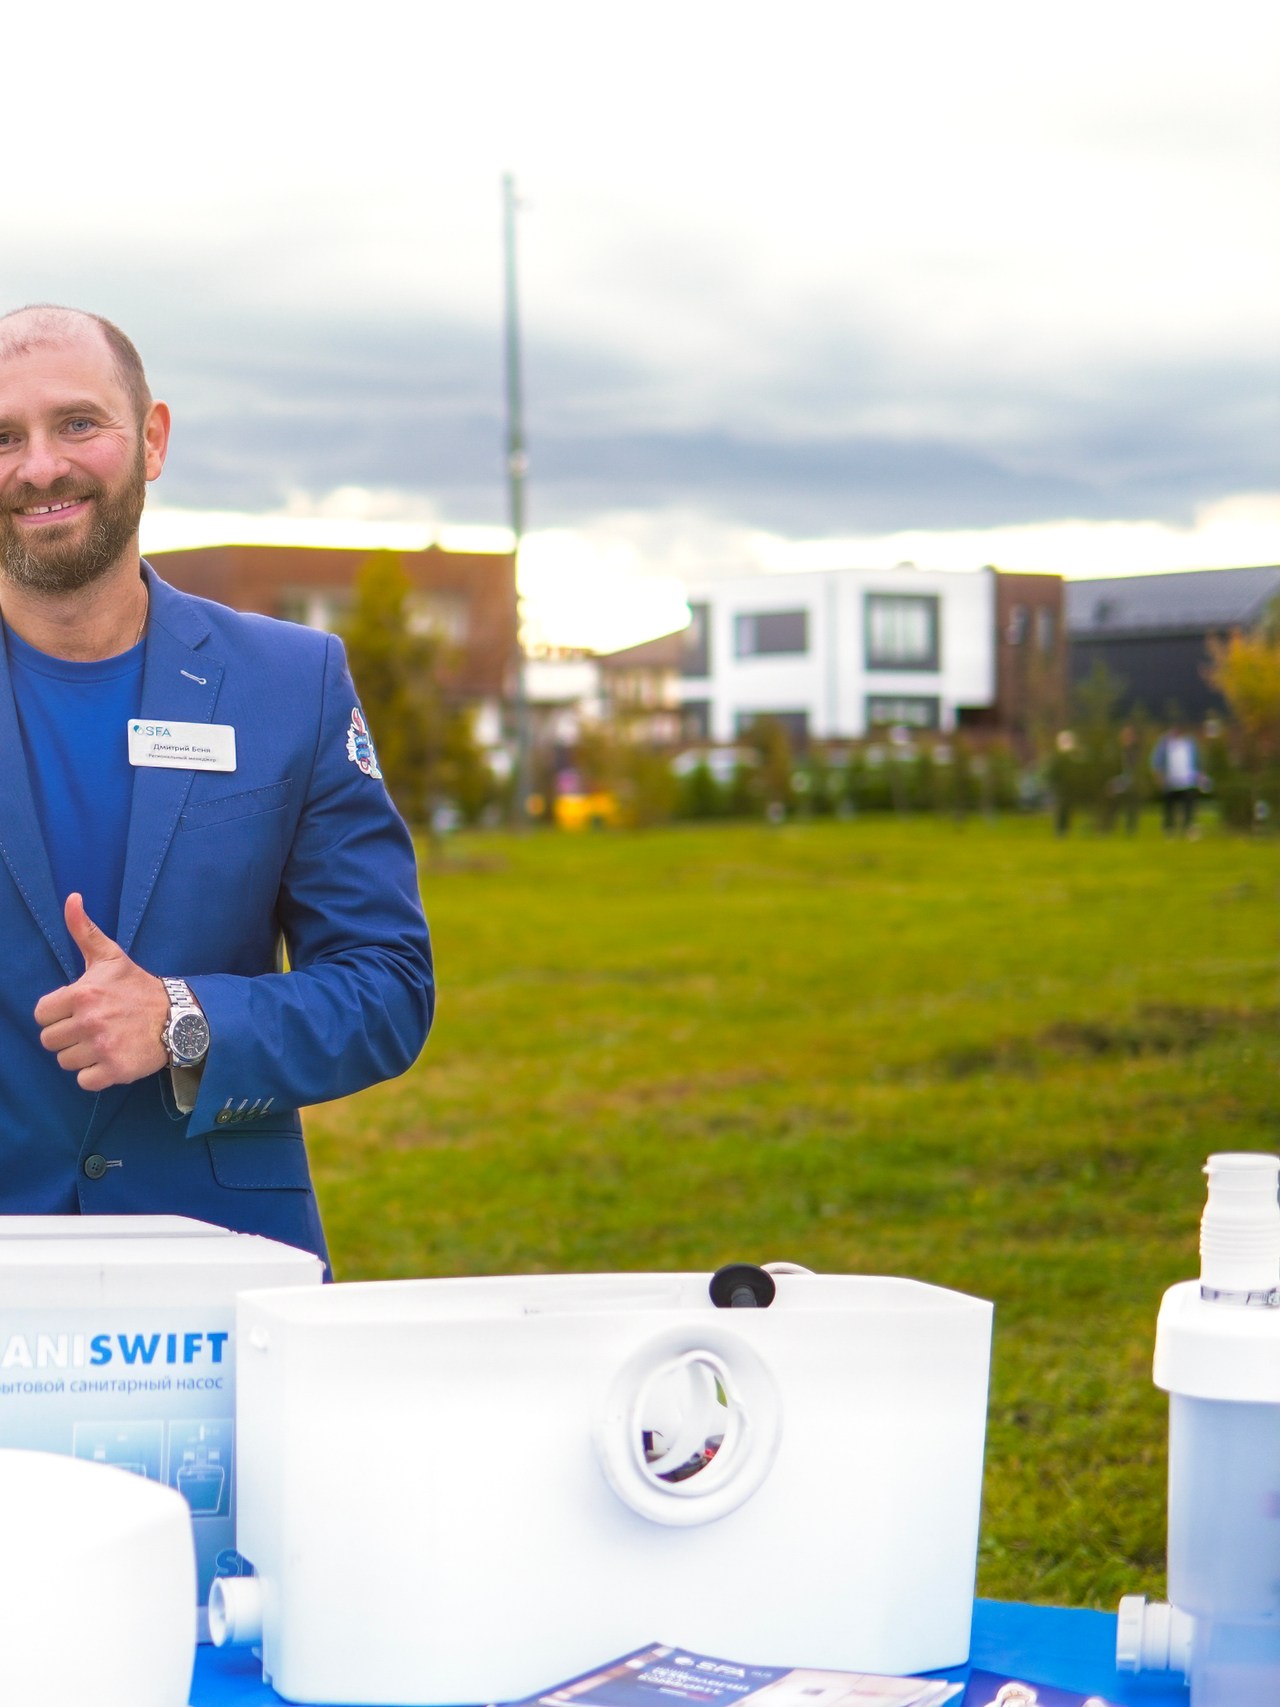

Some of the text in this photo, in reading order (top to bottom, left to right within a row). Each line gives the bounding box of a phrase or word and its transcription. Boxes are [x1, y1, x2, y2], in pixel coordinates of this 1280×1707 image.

[145, 726, 172, 737] SFA
[153, 743, 190, 753] Дмитрий
[70, 1375, 172, 1395] санитарный
[176, 1376, 224, 1391] насос
